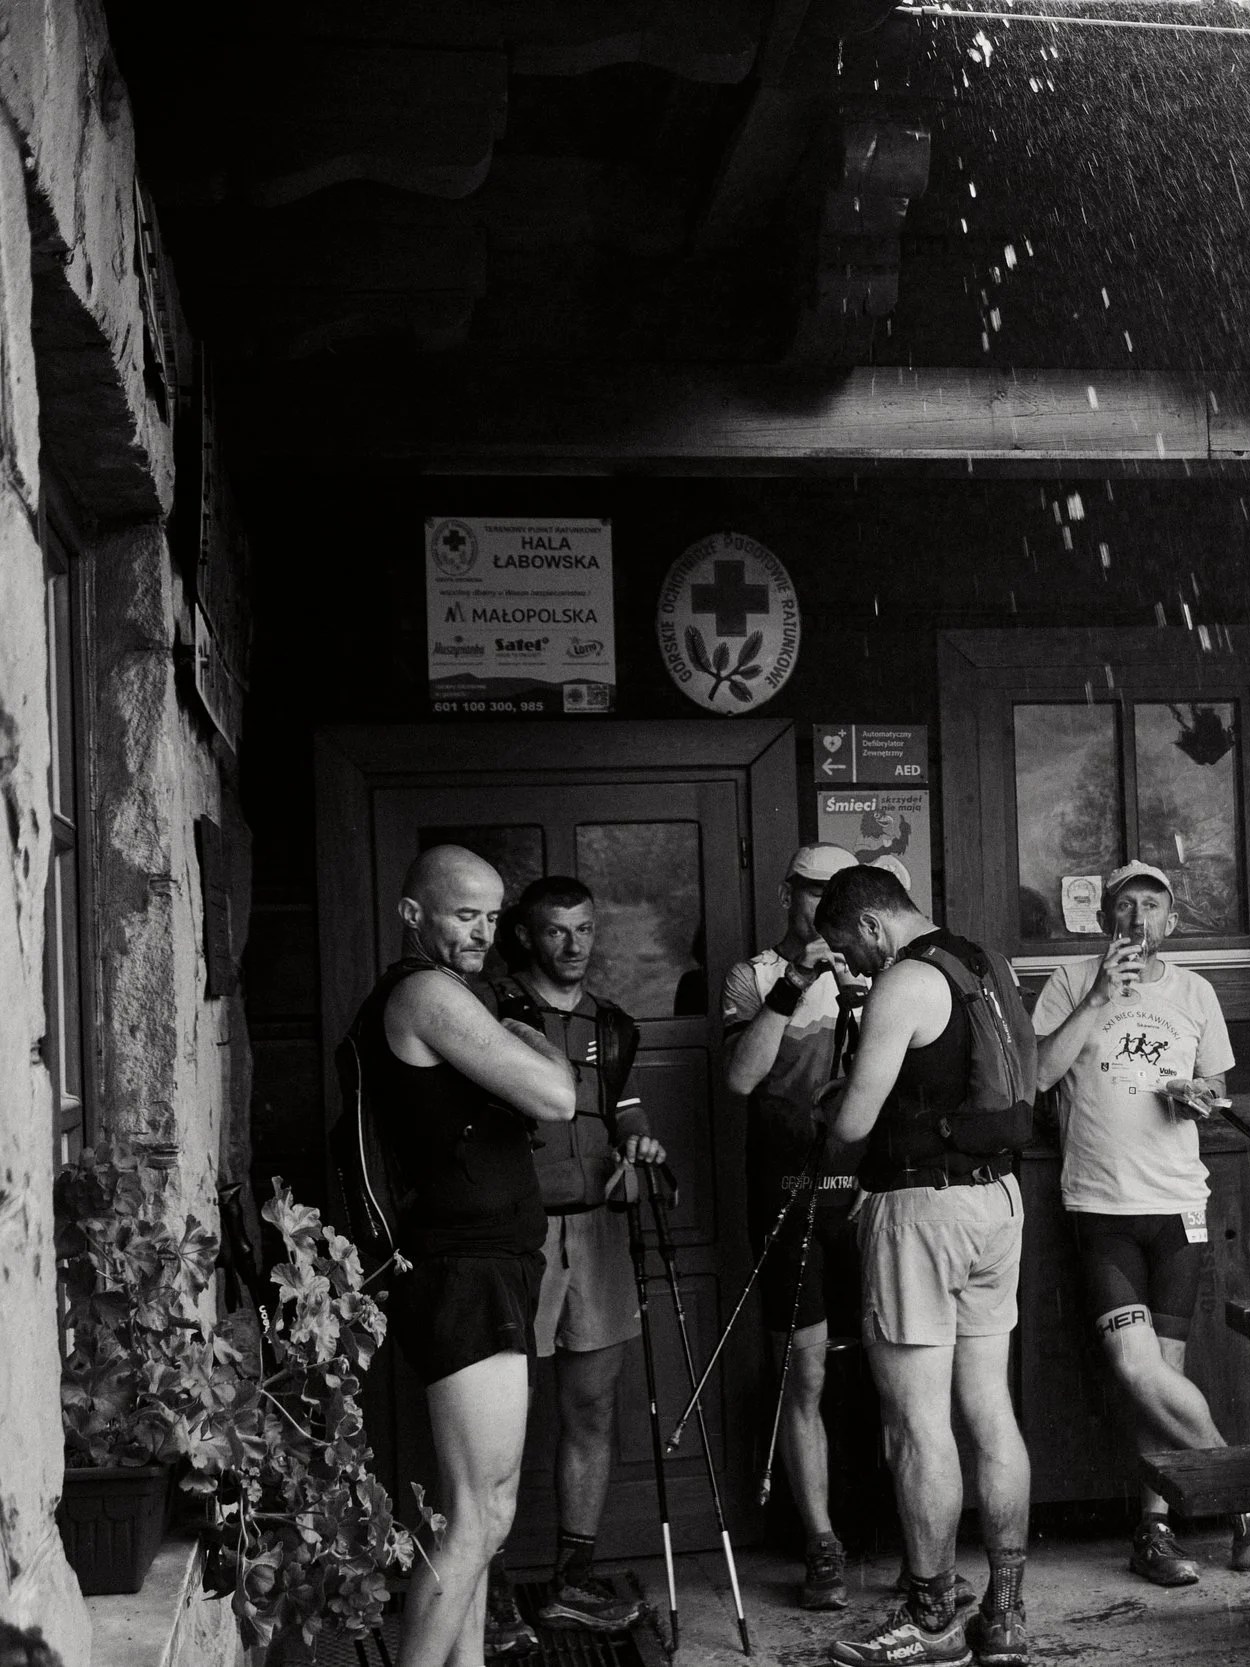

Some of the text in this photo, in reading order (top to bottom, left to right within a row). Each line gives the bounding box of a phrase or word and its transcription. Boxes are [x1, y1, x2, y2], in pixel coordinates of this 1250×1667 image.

[522, 536, 571, 550] HALA
[493, 555, 599, 569] ŁABOWSKA
[472, 608, 598, 623] MAŁOPOLSKA
[765, 599, 797, 689] RATUNKOWE
[434, 702, 544, 713] 601 100 300, 985
[862, 731, 912, 739] Automatyczny
[862, 740, 904, 749] Defibrylator
[862, 750, 904, 758] Zewnętrzny
[894, 765, 921, 776] AED
[826, 797, 877, 812] Śmieci
[1102, 1019, 1116, 1032] XXI
[1115, 1011, 1134, 1022] BIEG
[886, 1642, 925, 1661] HOKA
